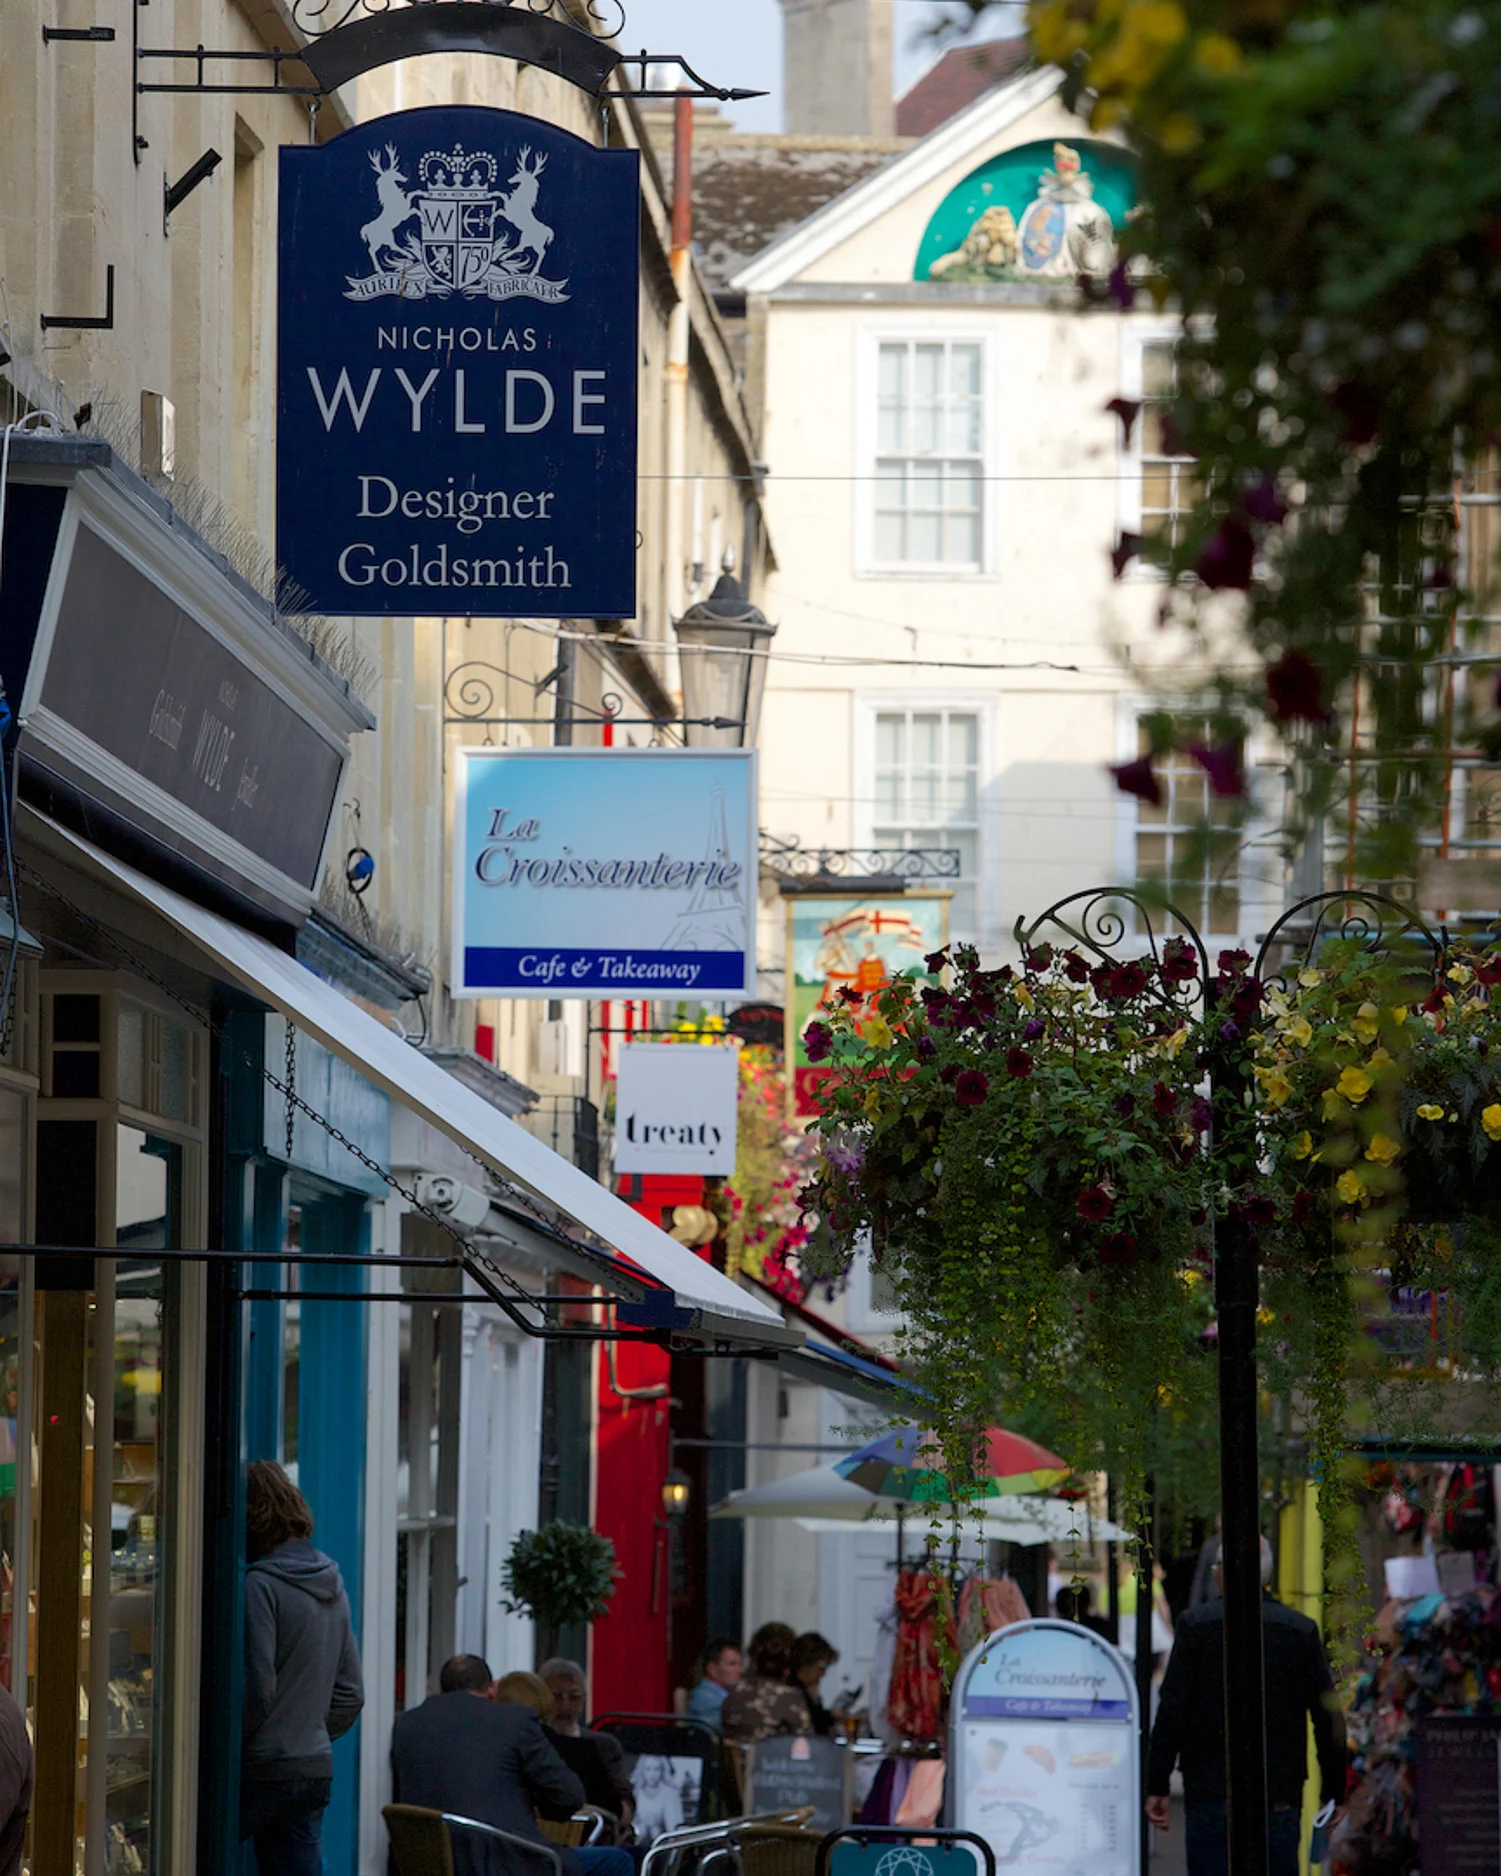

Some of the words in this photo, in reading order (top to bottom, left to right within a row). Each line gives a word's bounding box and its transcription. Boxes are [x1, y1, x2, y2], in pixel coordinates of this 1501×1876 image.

[424, 208, 454, 235] W
[378, 326, 537, 350] NICHOLAS
[307, 367, 606, 434] WYLDE
[356, 475, 554, 533] Designer
[338, 543, 572, 588] Goldsmith
[486, 808, 540, 841] La
[475, 845, 743, 890] Croissanterie
[518, 955, 566, 984] Cafe
[571, 958, 592, 977] &
[599, 956, 701, 985] Takeaway
[625, 1111, 723, 1155] treaty
